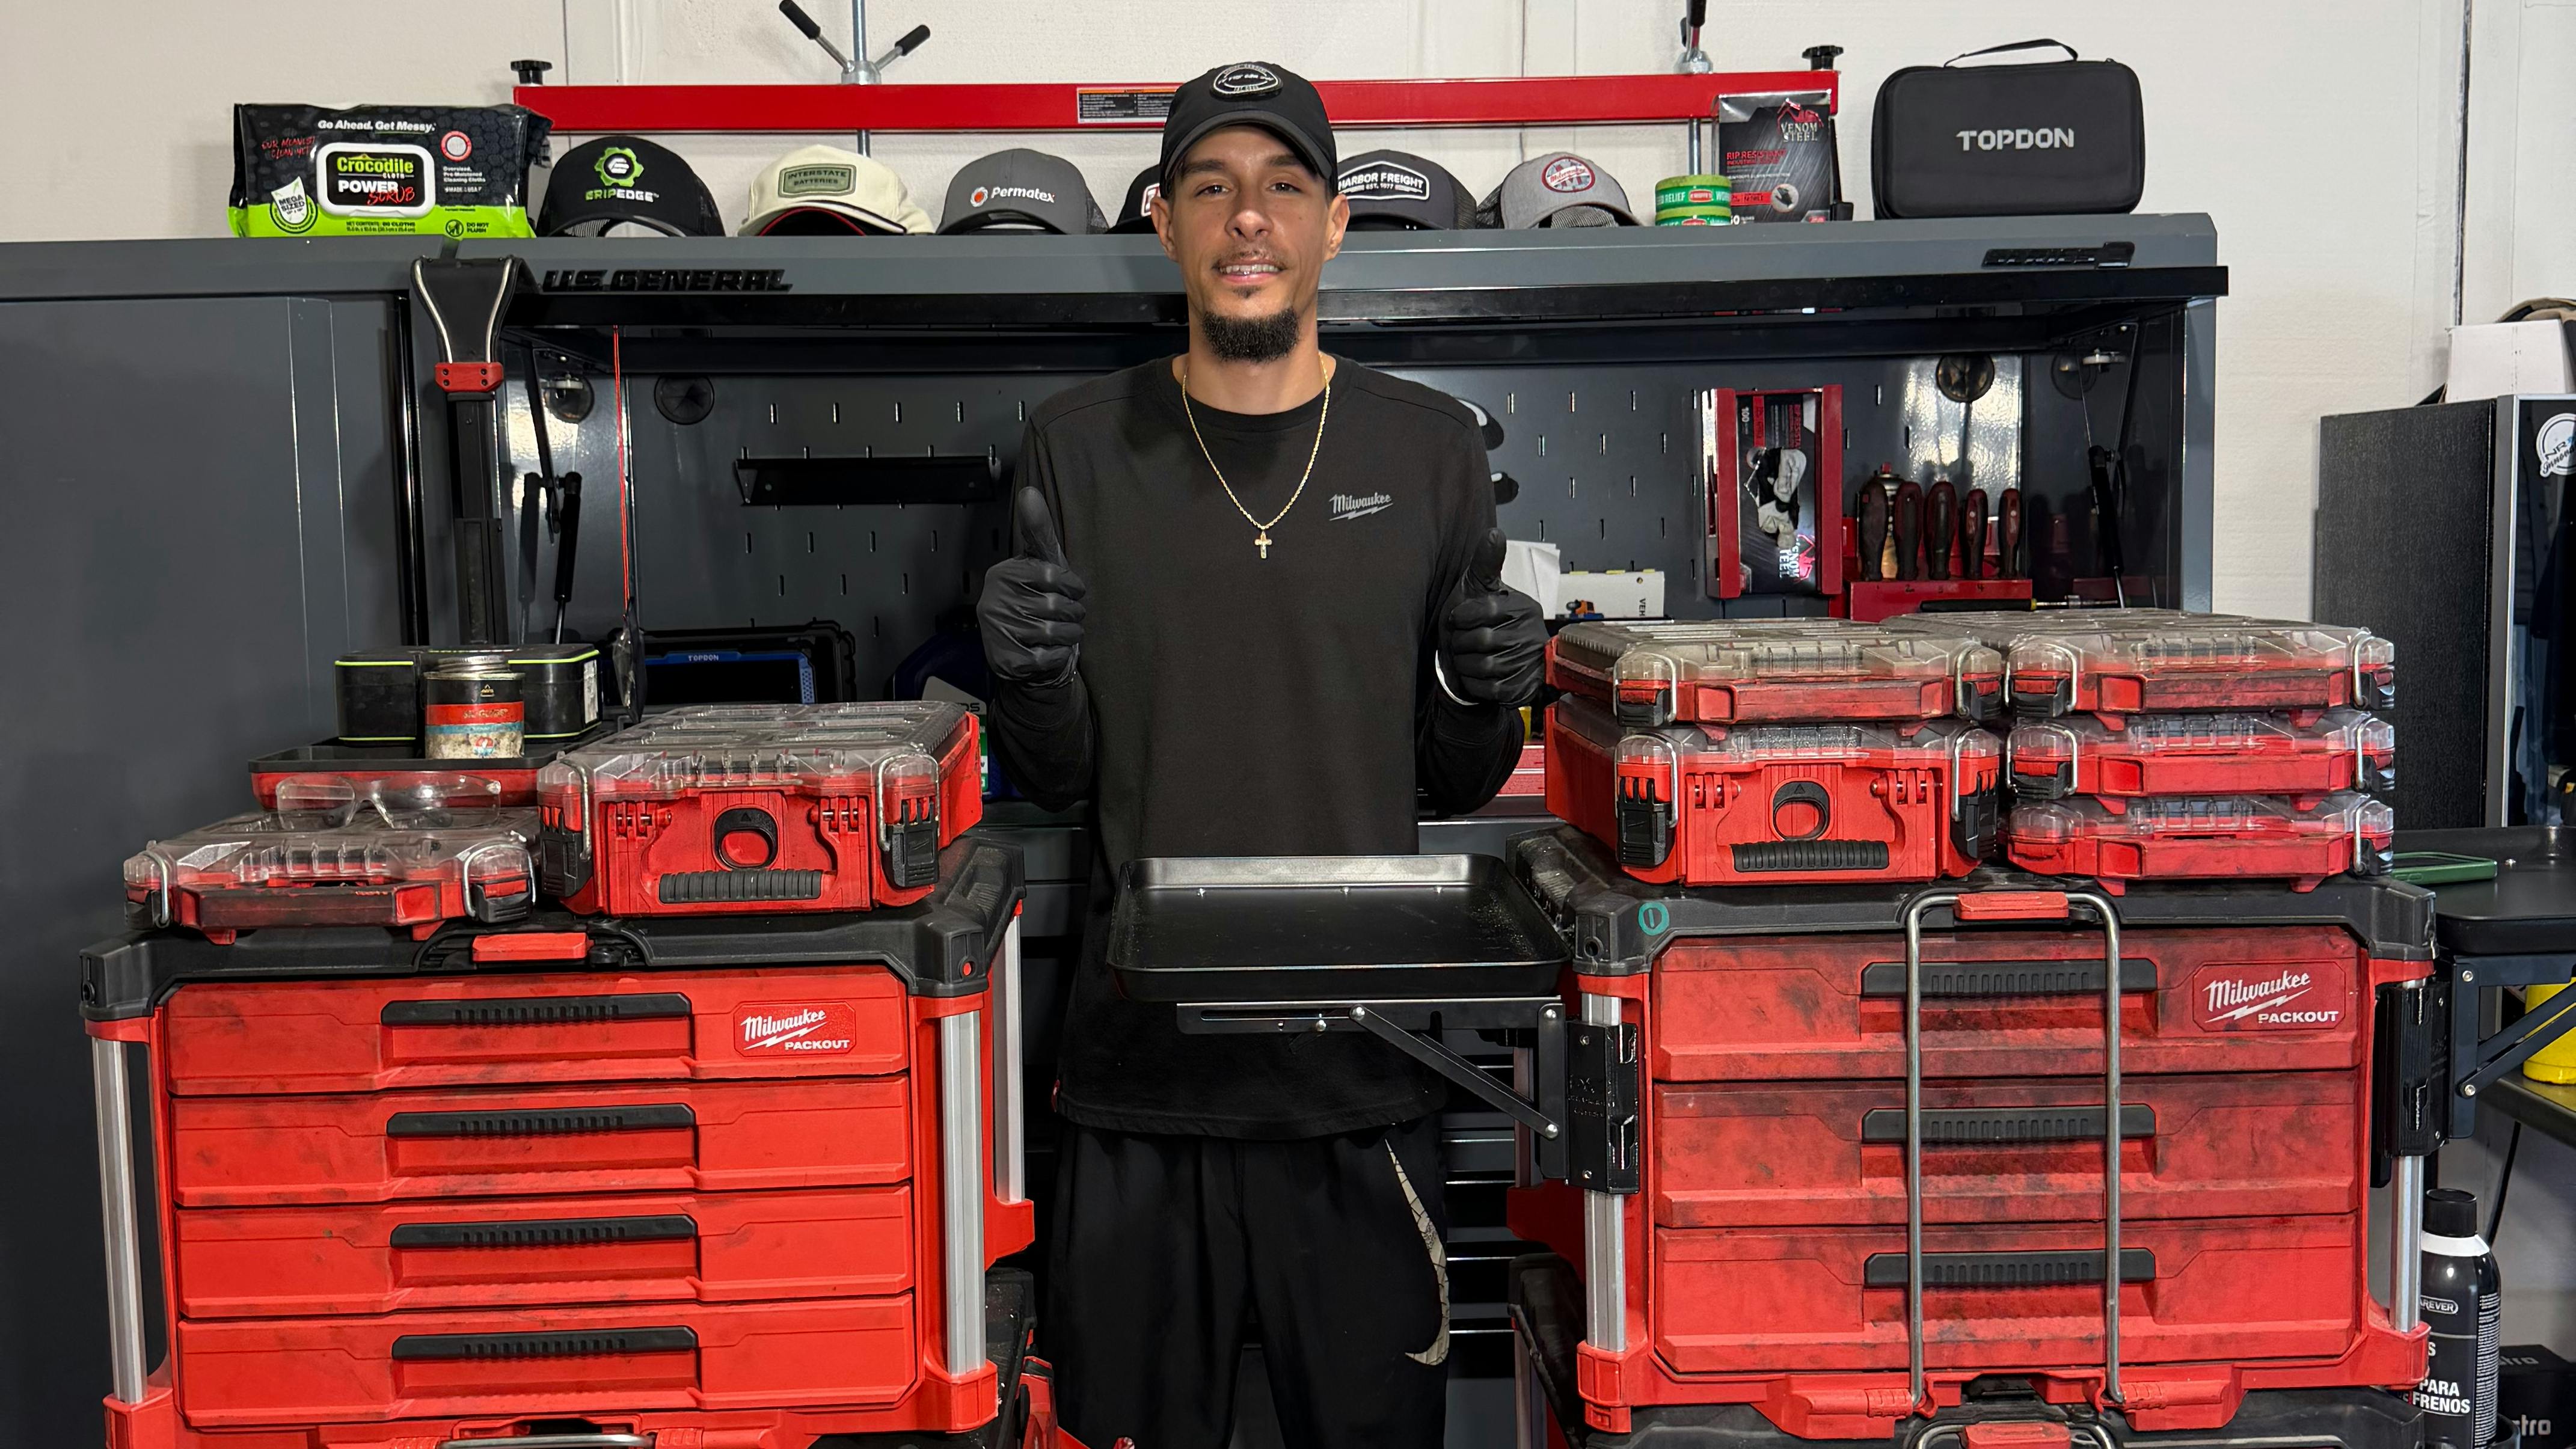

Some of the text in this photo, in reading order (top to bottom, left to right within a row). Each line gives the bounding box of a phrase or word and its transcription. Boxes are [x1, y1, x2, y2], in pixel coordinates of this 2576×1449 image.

[317, 120, 333, 129] Go
[335, 120, 373, 130] Ahead.
[375, 120, 394, 131] Get
[1781, 121, 1818, 132] VENOM
[1783, 132, 1818, 142] STEEL
[1955, 127, 2075, 151] TOPDON
[1726, 151, 1740, 161] RIP
[337, 156, 414, 174] Crocodile
[787, 169, 847, 180] INTERSTATE
[793, 177, 839, 186] BATTERIES
[1339, 172, 1424, 191] HARBOR FREIGHT
[338, 180, 399, 194] POWER
[585, 188, 654, 203] GRIPEDGE
[990, 185, 1055, 203] Permatex
[278, 194, 304, 204] MEGA
[367, 186, 415, 206] SCRUB
[1664, 191, 1686, 204] RELIEF
[281, 201, 305, 212] SIZED
[608, 269, 793, 292] GENERAL
[1741, 406, 1750, 423] 100
[1328, 492, 1393, 514] Milwaukee
[1779, 549, 1791, 578] TEEL
[2201, 970, 2311, 1012] Milwaukee
[740, 1008, 827, 1042] Milwaukee
[2258, 1011, 2339, 1024] PACKOUT
[785, 1040, 850, 1051] PACKOUT
[2419, 1379, 2461, 1397] PARA
[2412, 1391, 2471, 1414] FRENOS
[2512, 1414, 2552, 1436] tro
